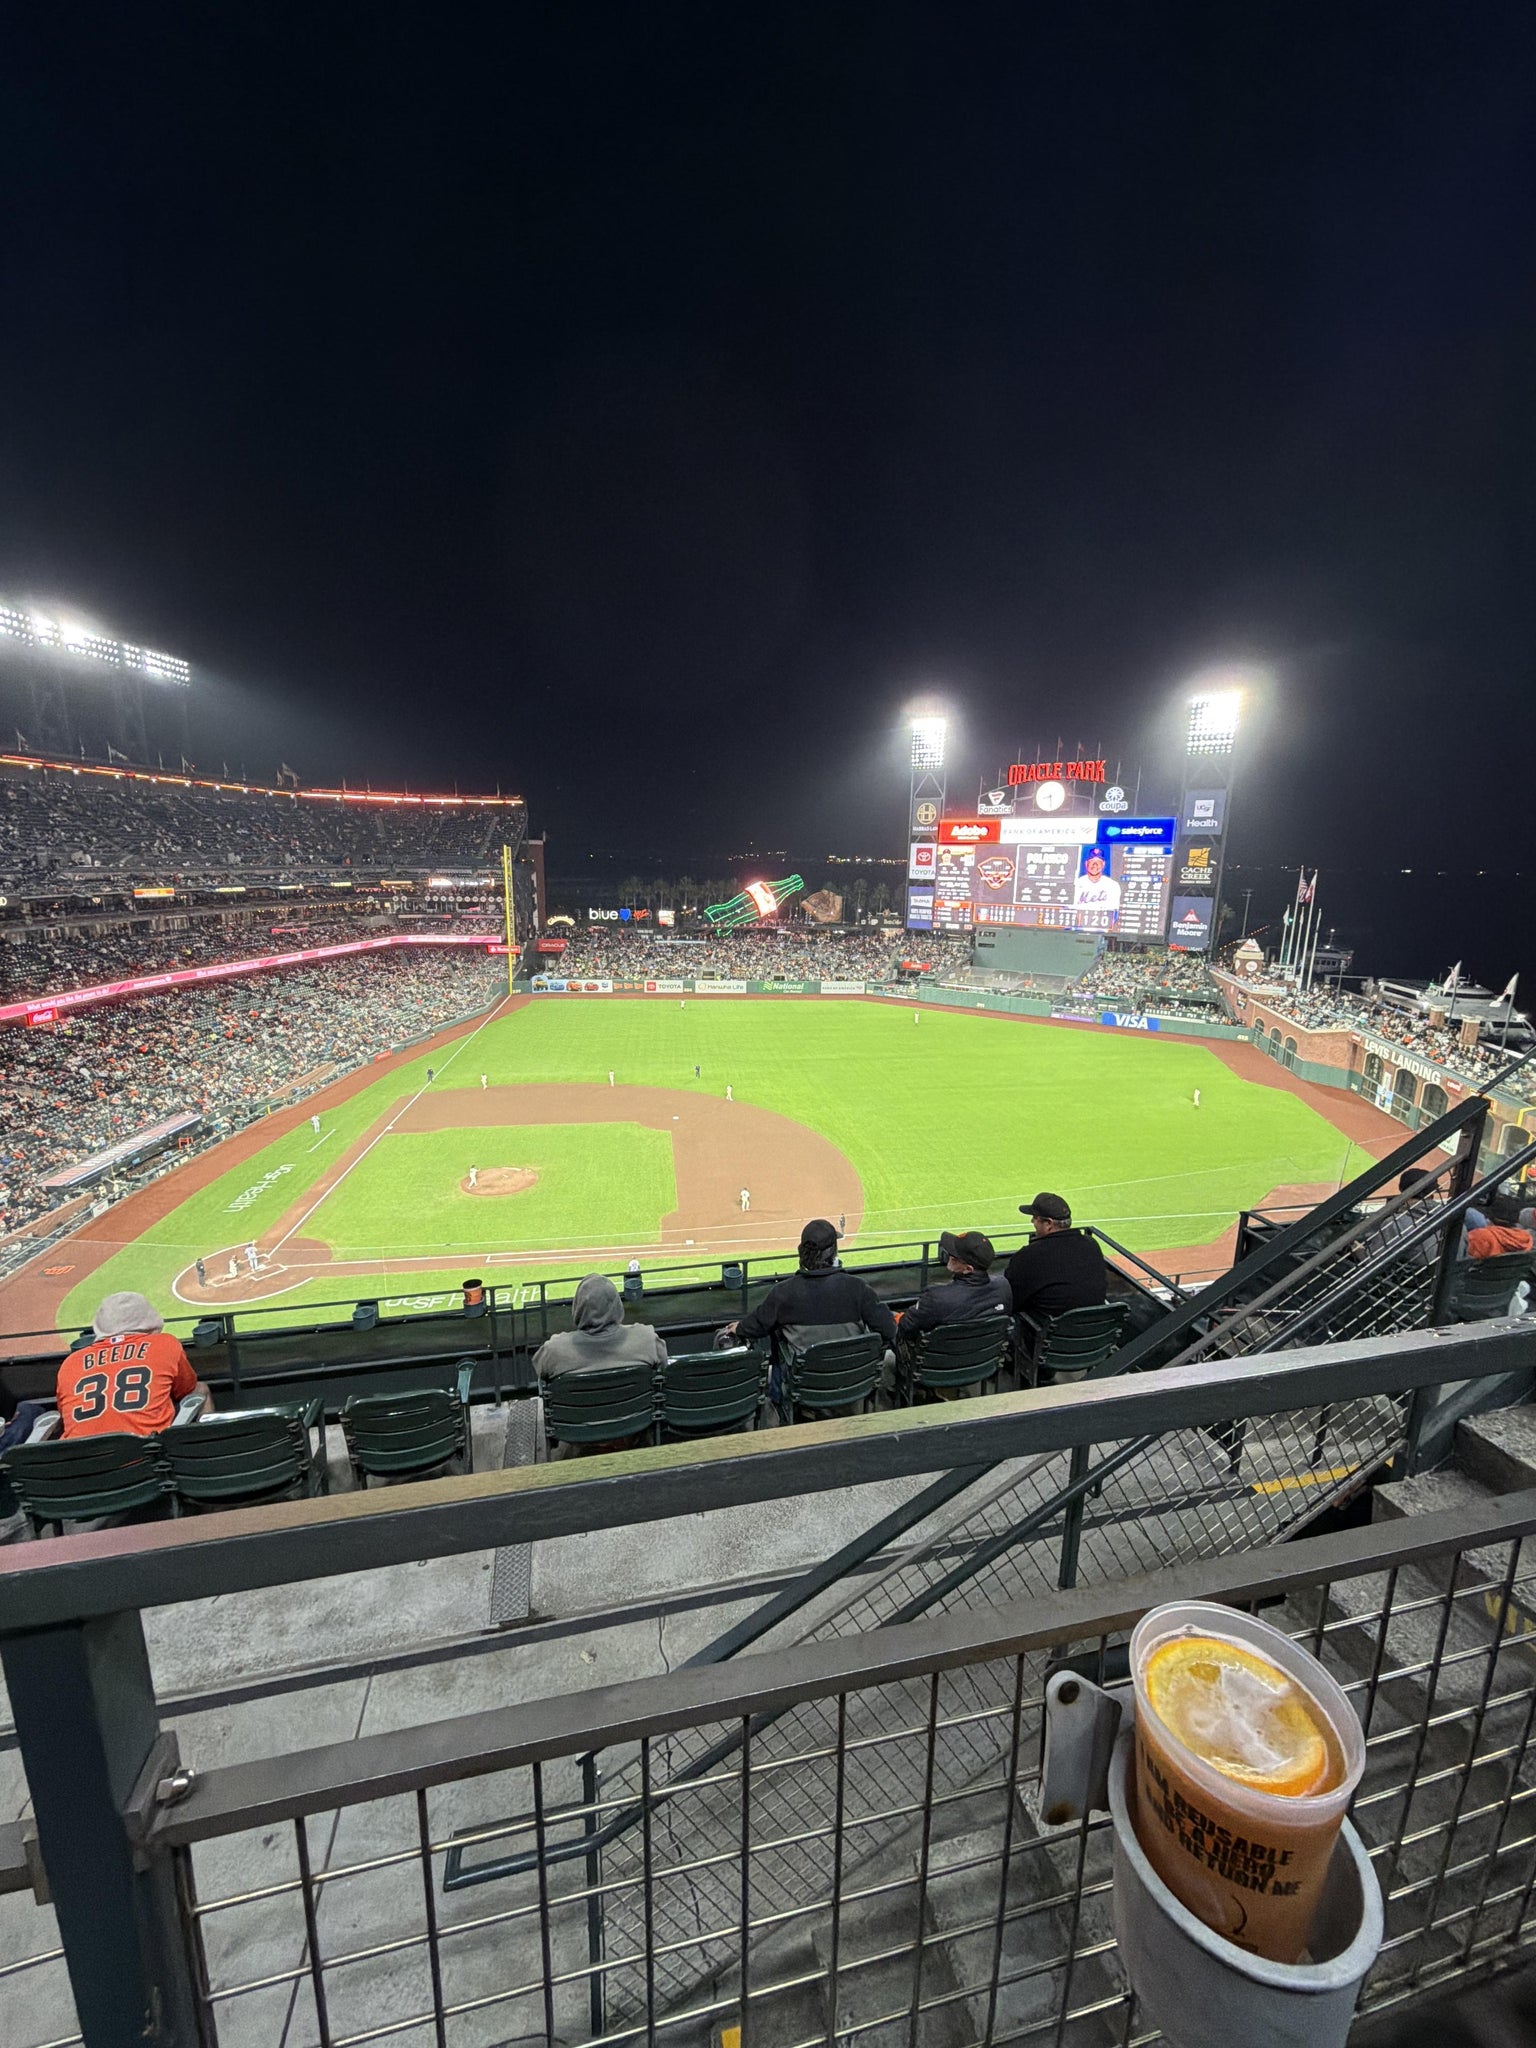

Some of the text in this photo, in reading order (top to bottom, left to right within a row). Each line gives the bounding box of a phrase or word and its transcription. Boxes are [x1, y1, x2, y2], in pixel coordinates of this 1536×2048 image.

[1008, 760, 1106, 786] ORACLE PARK
[979, 804, 1013, 815] Fanatics
[1100, 801, 1127, 813] coupa
[950, 825, 988, 836] Adobe
[1187, 819, 1218, 828] Health
[1121, 826, 1163, 836] salesforce
[1078, 890, 1107, 904] Mets
[589, 907, 618, 920] blue
[1091, 916, 1099, 926] 2
[1101, 916, 1109, 926] 0
[1173, 921, 1207, 931] Benjamin
[1177, 929, 1202, 937] Moore
[773, 982, 805, 990] National
[1113, 1013, 1149, 1030] VISA
[1391, 1051, 1441, 1084] LANDING
[222, 1180, 278, 1213] Health
[448, 1287, 548, 1308] Halth
[83, 1341, 150, 1371] BEEDE
[72, 1364, 153, 1423] 38
[1173, 1789, 1295, 1866] REUSABLE
[1192, 1824, 1206, 1848] A
[1211, 1838, 1276, 1881] HERO
[1178, 1829, 1268, 1894] RETURN
[1271, 1879, 1304, 1896] ME
